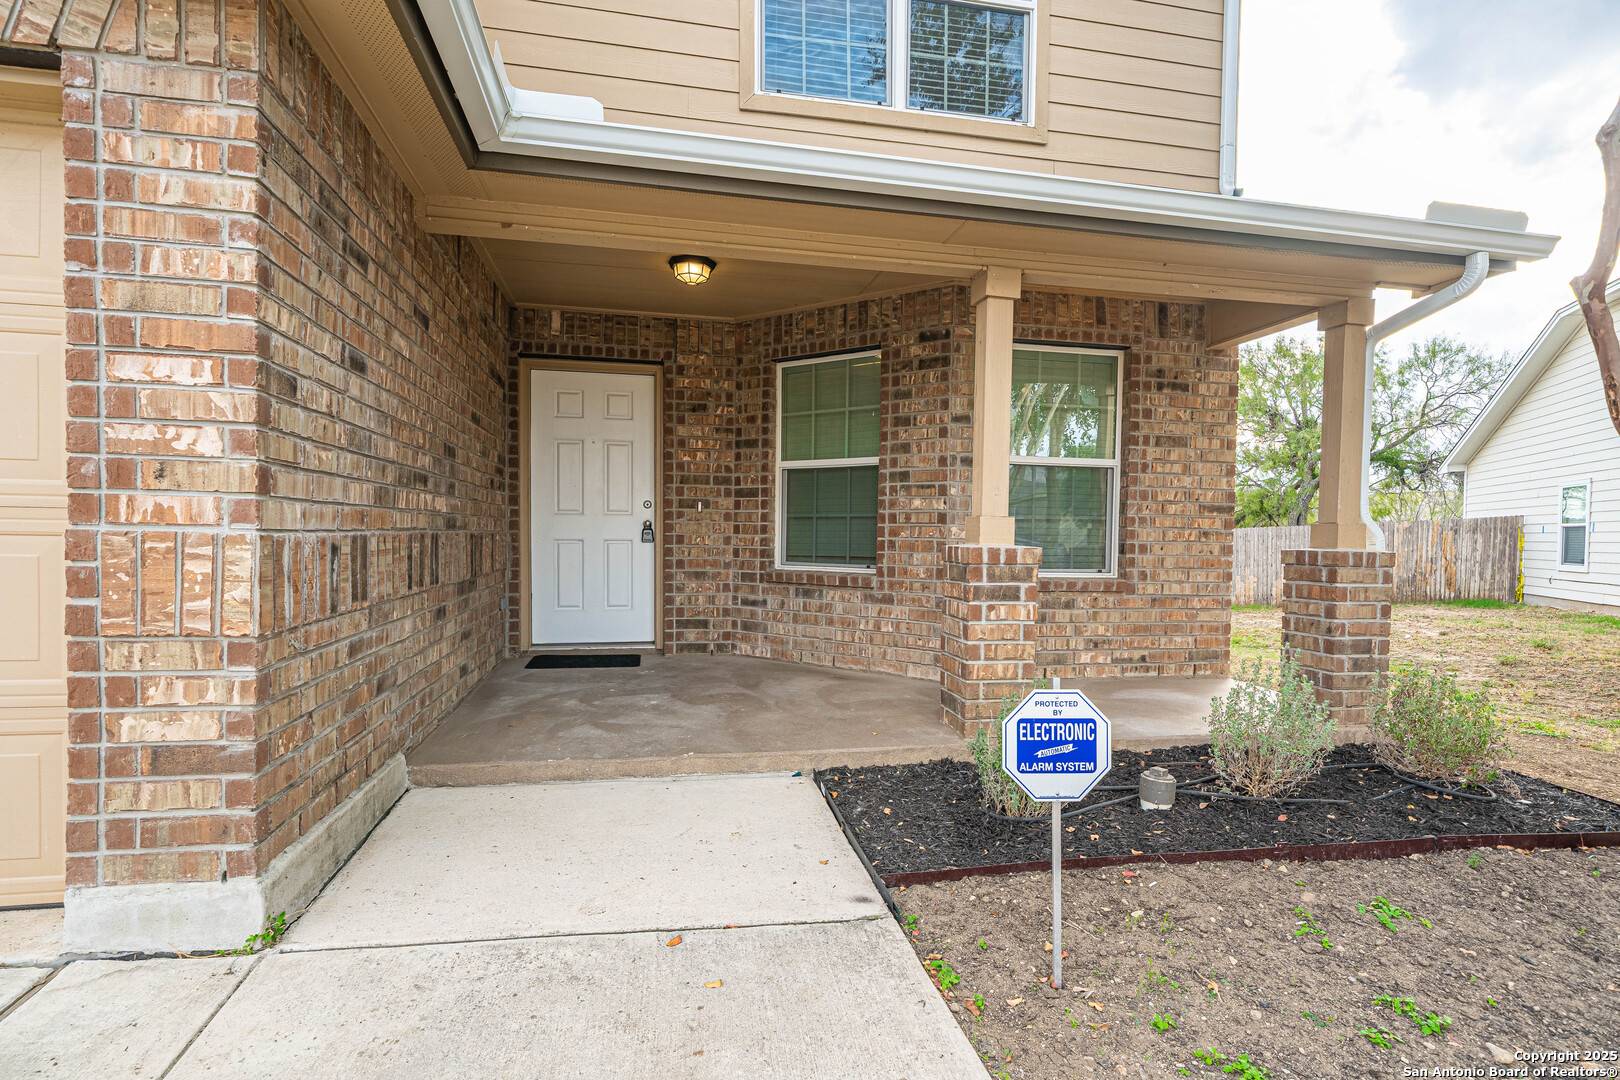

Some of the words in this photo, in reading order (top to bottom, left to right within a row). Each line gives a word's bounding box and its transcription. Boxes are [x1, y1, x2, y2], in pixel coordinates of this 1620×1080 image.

[1020, 722, 1094, 740] ELECTRONIC
[1040, 745, 1071, 756] AUTOMATIC
[1019, 762, 1054, 771] ALARM
[1055, 762, 1094, 771] SYSTEM
